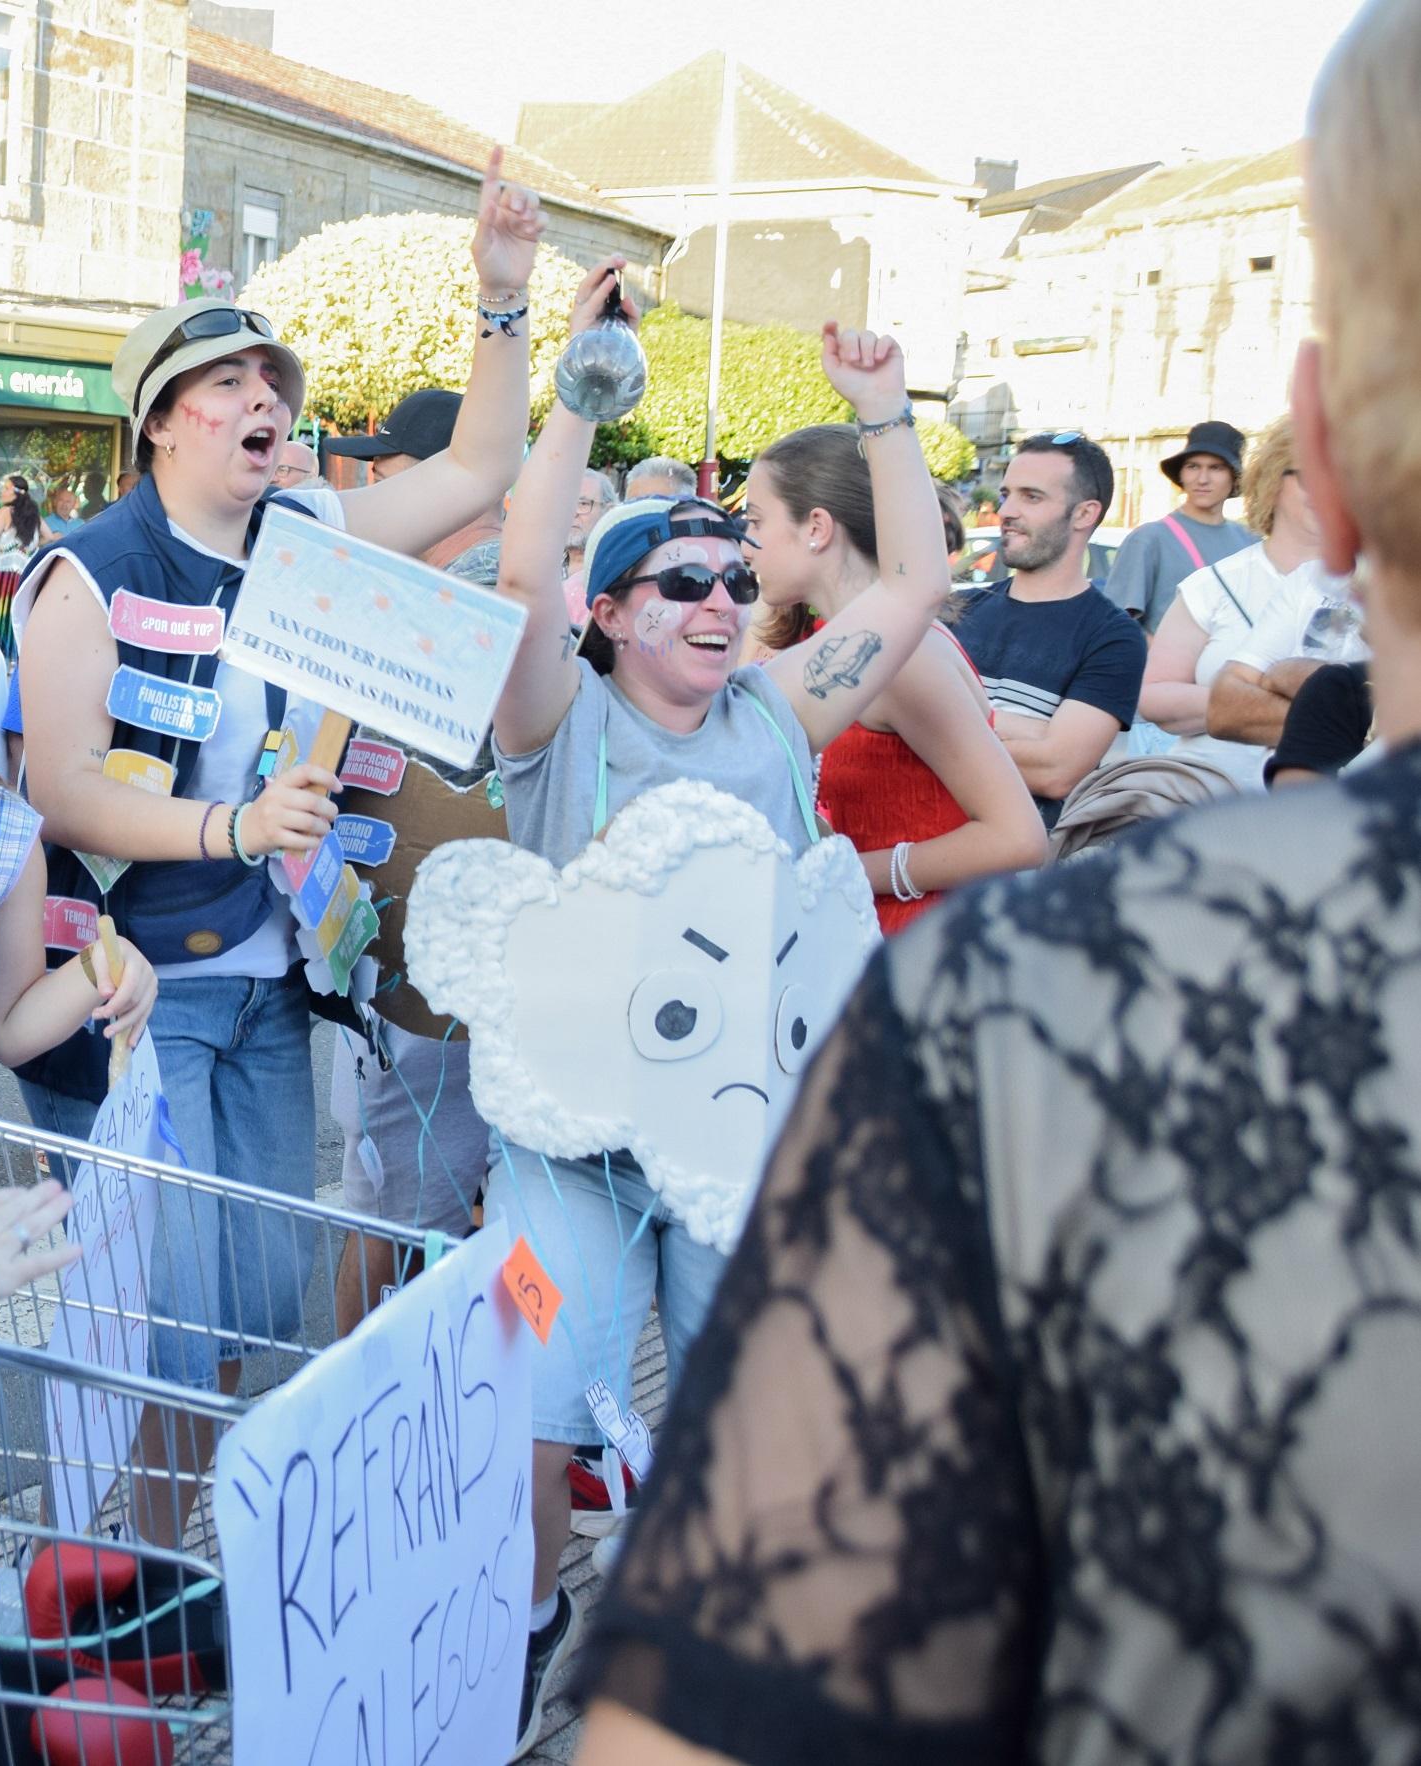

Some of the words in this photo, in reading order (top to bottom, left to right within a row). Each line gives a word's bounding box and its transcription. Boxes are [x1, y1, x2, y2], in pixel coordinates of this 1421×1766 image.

[10, 370, 84, 398] enerxía
[141, 616, 167, 633] ¿POR
[170, 621, 190, 636] QUÉ
[194, 623, 214, 637] YO?
[269, 609, 299, 636] VAN
[303, 626, 375, 667] CHOVER
[377, 656, 456, 702] HOSTIAS
[138, 686, 194, 714] FINALISTA
[195, 700, 214, 717] SIN
[264, 640, 294, 664] TES
[298, 654, 354, 689] TODAS
[356, 681, 378, 700] AS
[380, 690, 478, 743] PAPELETAS
[337, 821, 373, 840] PREMIO
